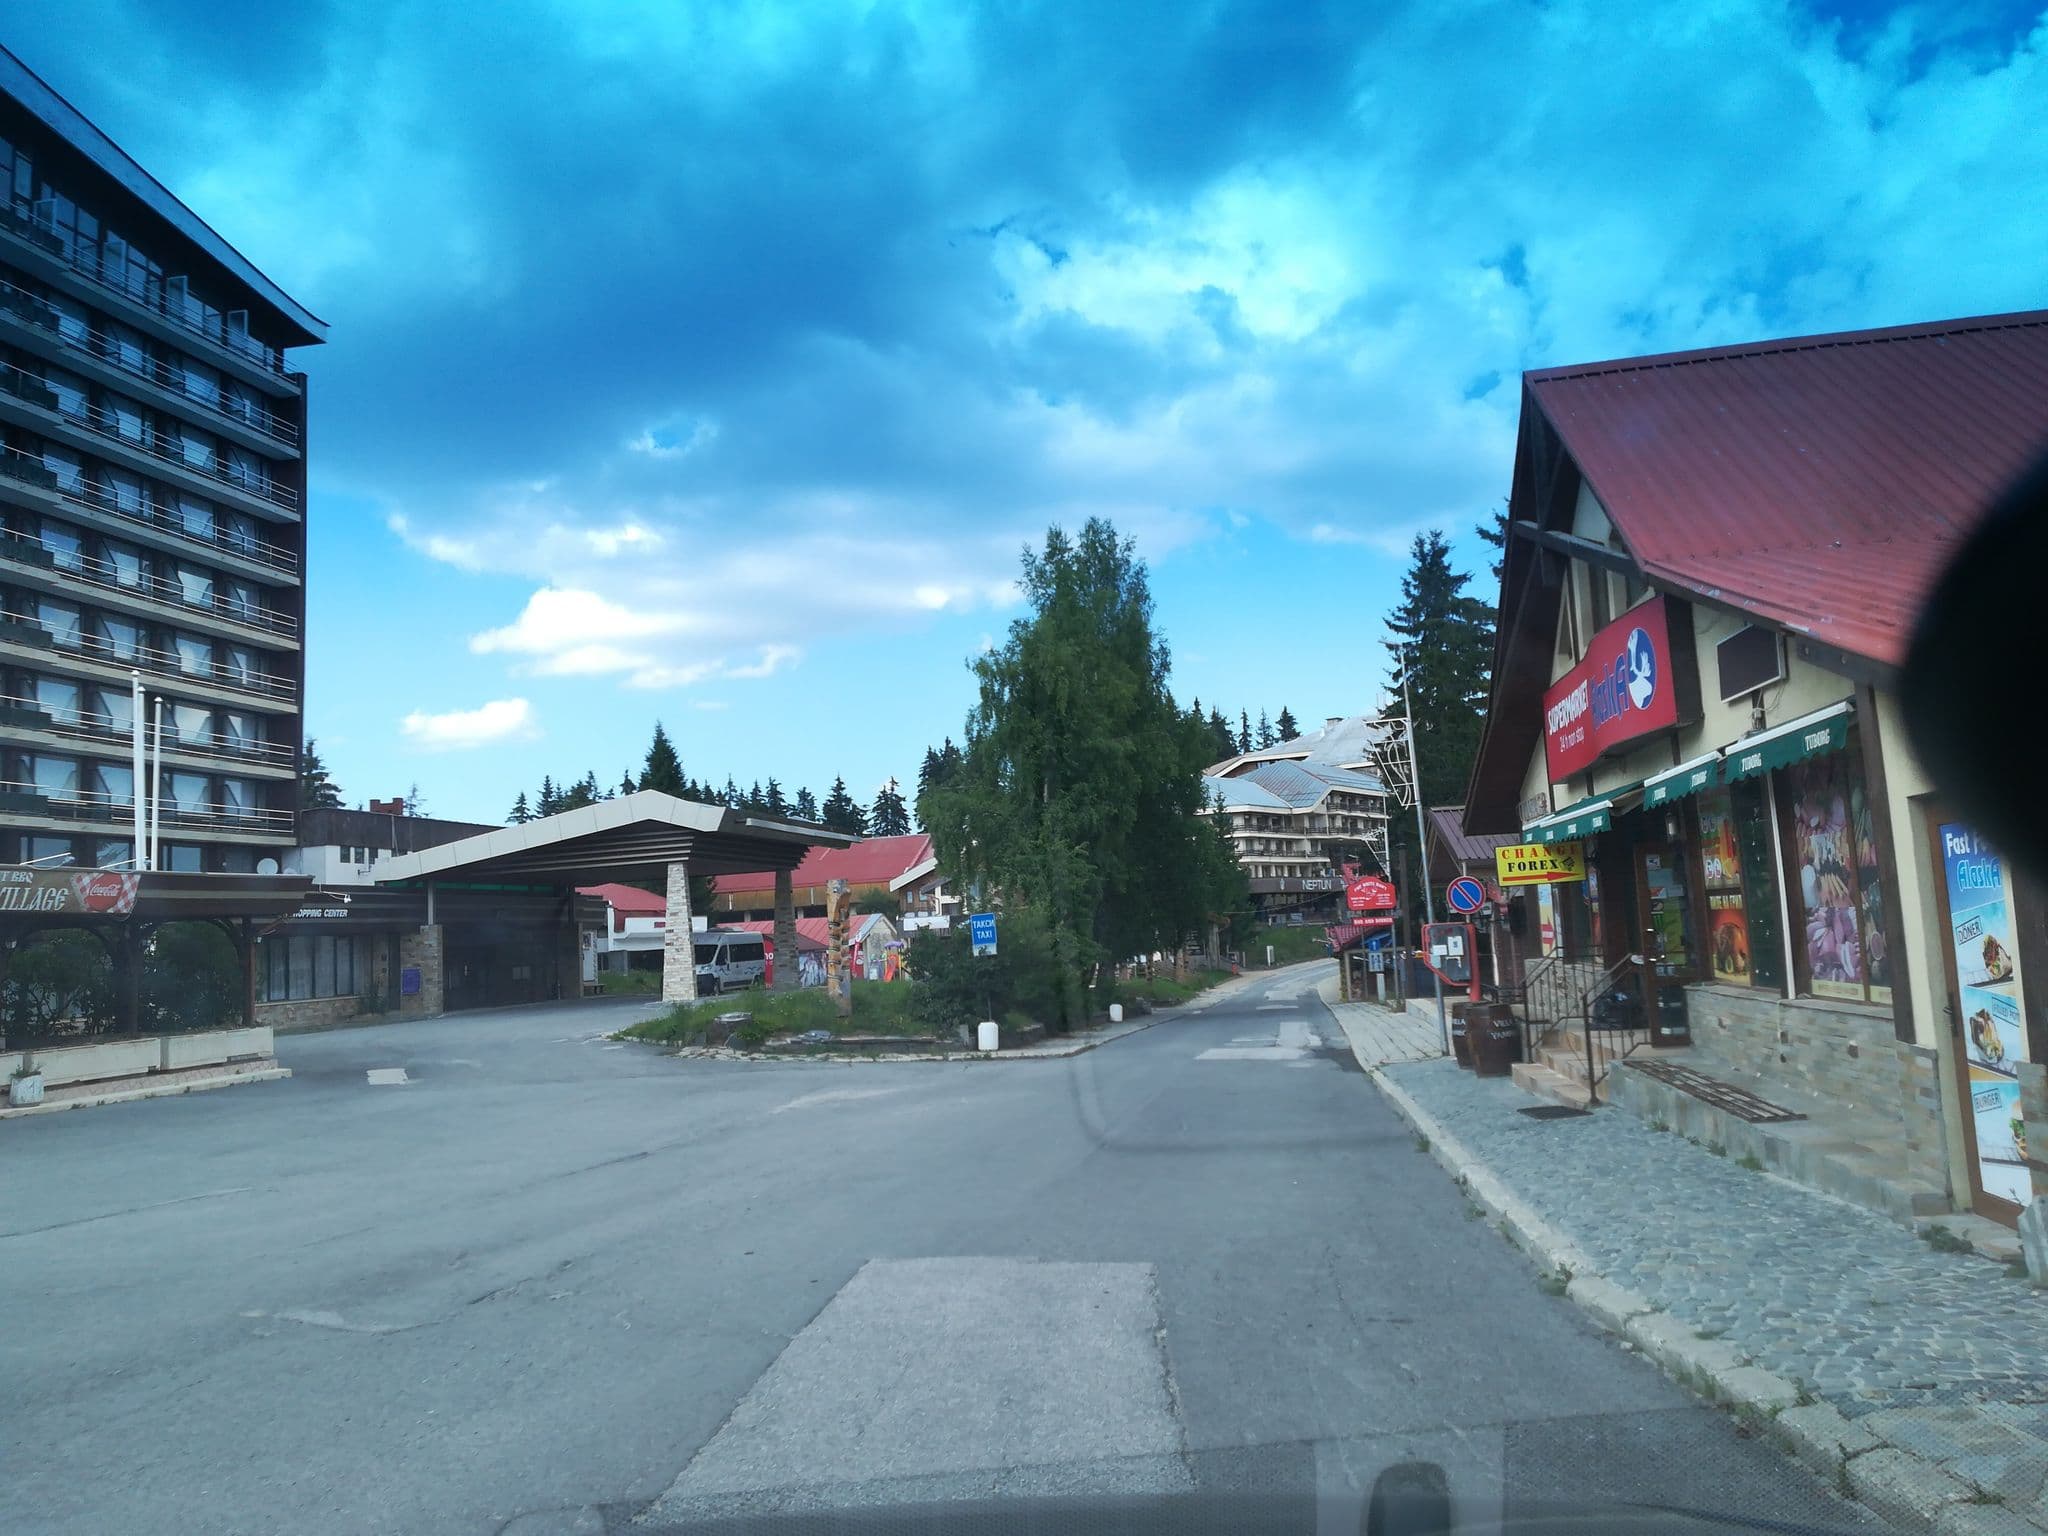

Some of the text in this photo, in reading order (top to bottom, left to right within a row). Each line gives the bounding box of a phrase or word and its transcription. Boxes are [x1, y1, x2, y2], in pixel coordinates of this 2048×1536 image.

[1547, 679, 1588, 736] SUPERMARKET
[1805, 728, 1830, 752] TUBORG
[1741, 753, 1761, 772] TUBORG
[1502, 844, 1577, 860] CHANGE
[1945, 832, 1970, 858] Fast
[1508, 859, 1559, 873] FOREX
[11, 871, 33, 883] BBQ
[1302, 879, 1332, 890] NEPTUN
[323, 908, 348, 917] CENTER
[973, 919, 995, 929] ТАКСИ
[1958, 920, 1981, 942] DÖNER
[976, 930, 993, 939] TAXI
